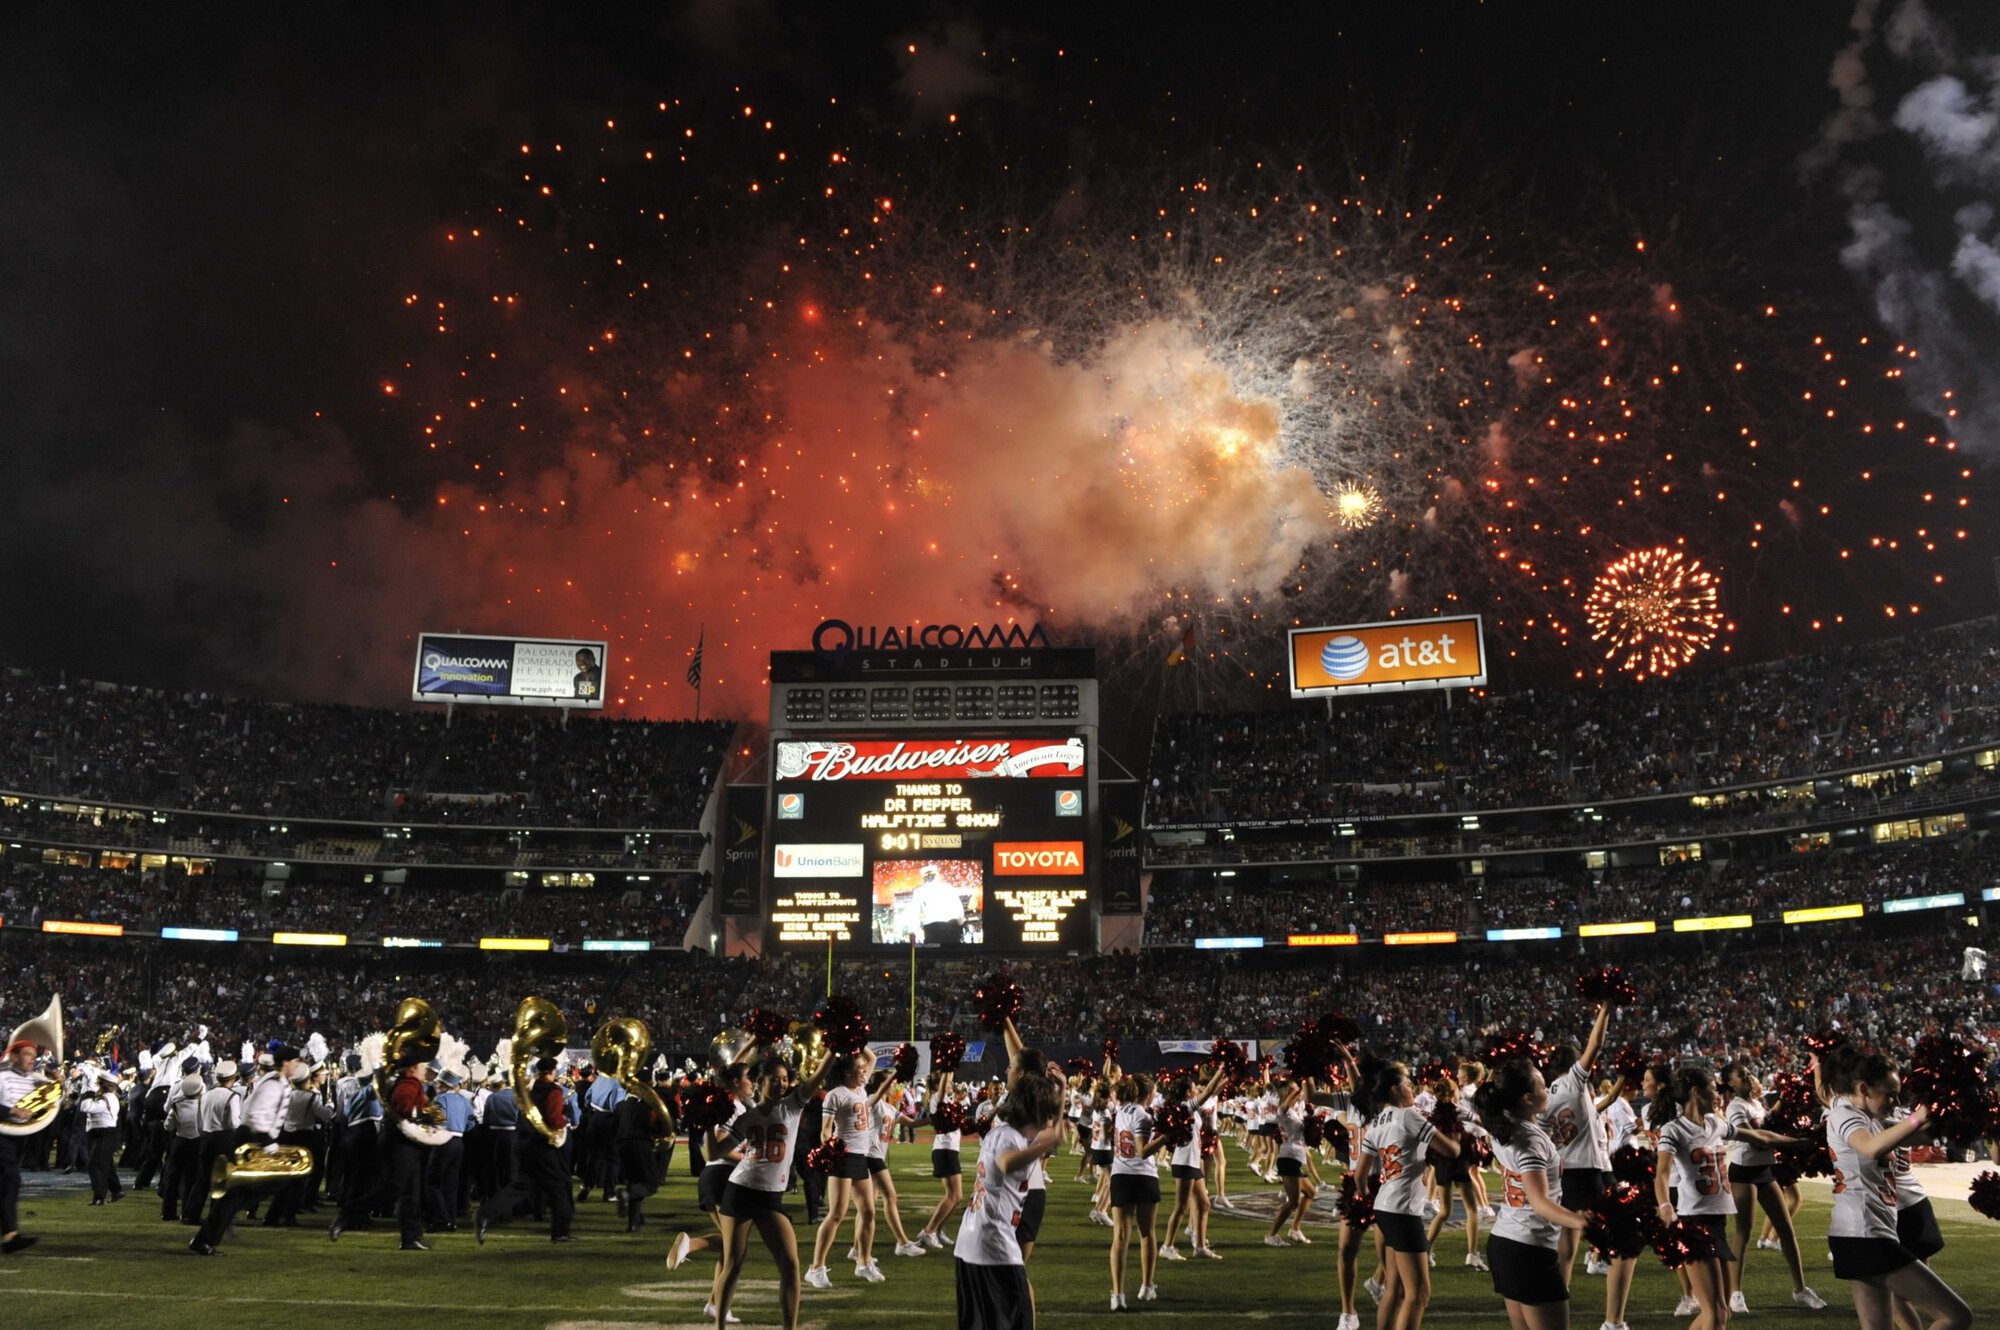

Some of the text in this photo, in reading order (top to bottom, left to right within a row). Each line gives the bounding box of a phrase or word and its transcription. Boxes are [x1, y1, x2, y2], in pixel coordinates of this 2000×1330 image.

[812, 619, 1049, 653] QUALCOMM
[518, 648, 573, 657] PALOMAR
[1378, 634, 1456, 668] at&t
[425, 654, 508, 671] QUALCOMM
[517, 658, 574, 667] POMERADO
[862, 657, 1031, 668] STADIUM
[516, 667, 573, 677] HEALTH
[520, 686, 566, 695] www.pph.org
[804, 740, 1010, 780] Budweiser
[1013, 751, 1081, 770] American Lager
[896, 784, 962, 796] THANKS TO
[884, 798, 972, 812] DR PEPPER
[862, 813, 999, 828] HALFTIME SHOW
[882, 834, 920, 850] 9:07
[923, 836, 961, 846] SYCUAN
[726, 849, 758, 862] Sprint
[998, 851, 1080, 867] TOYOTA
[1104, 846, 1137, 860] Sprint
[994, 890, 1087, 900] THE PACIFIC LIFE
[1290, 935, 1356, 945] WELLS FARGO
[748, 1123, 789, 1163] 36
